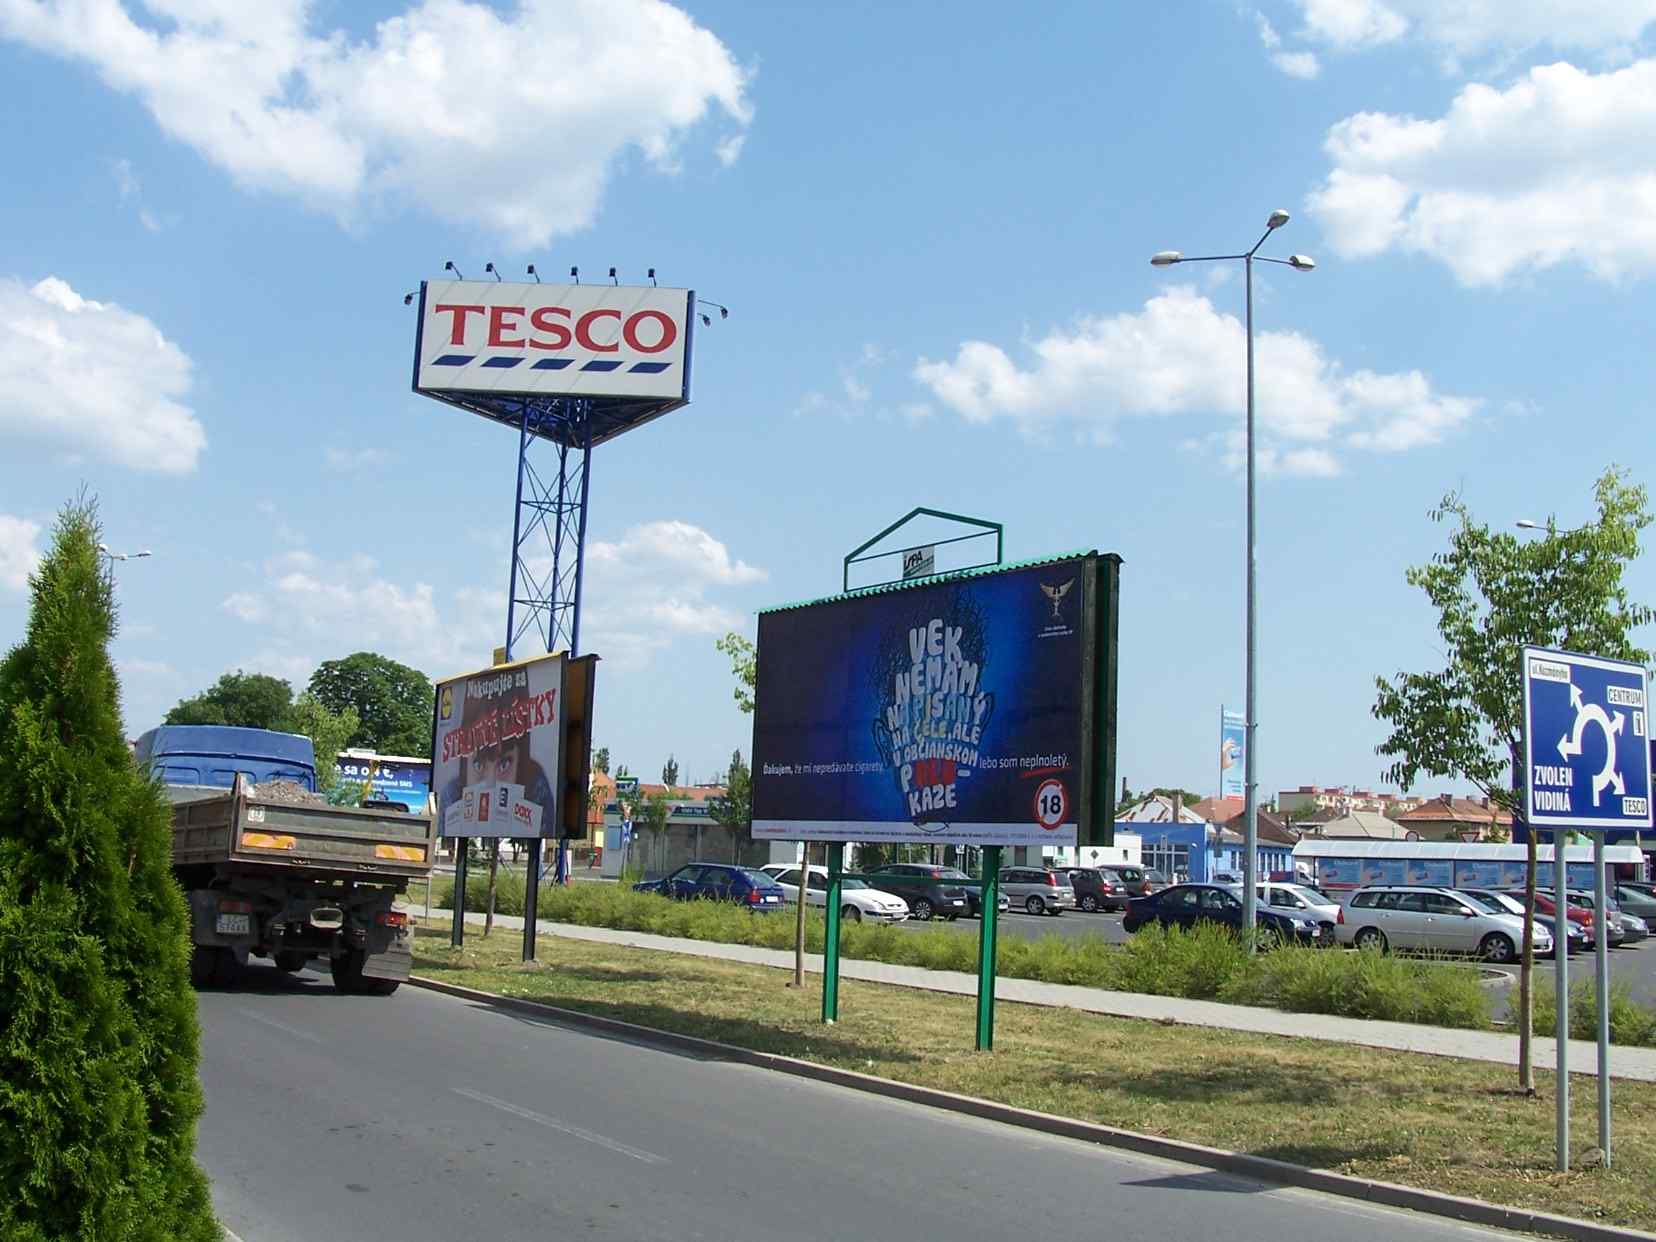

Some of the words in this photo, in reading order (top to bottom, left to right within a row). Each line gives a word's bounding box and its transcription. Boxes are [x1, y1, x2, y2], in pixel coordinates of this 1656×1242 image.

[435, 304, 677, 354] TESCO
[909, 619, 963, 664] VEK
[1608, 688, 1642, 705] CENTRUM
[979, 755, 998, 769] lebo
[999, 757, 1018, 769] som
[1534, 765, 1573, 787] ZVOLEN
[1040, 795, 1061, 815] 18
[1534, 788, 1571, 812] VIDINÁ
[1624, 799, 1646, 814] TESCO
